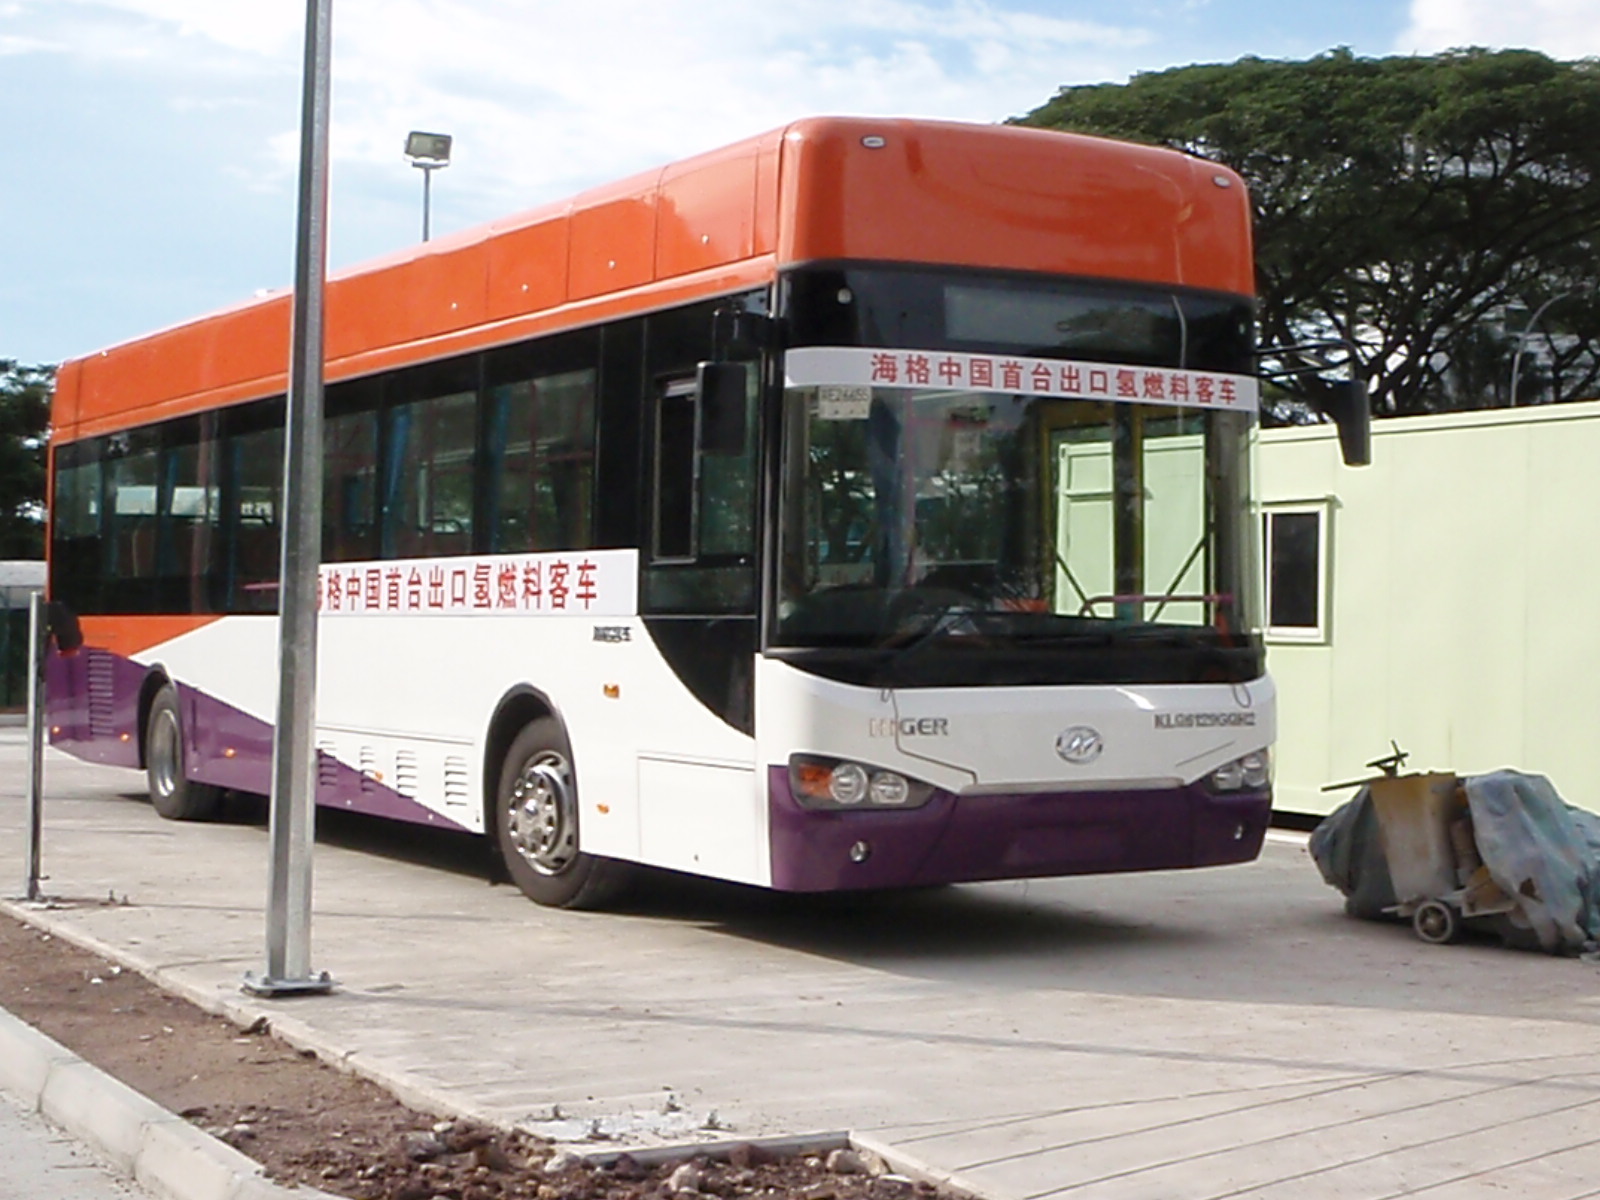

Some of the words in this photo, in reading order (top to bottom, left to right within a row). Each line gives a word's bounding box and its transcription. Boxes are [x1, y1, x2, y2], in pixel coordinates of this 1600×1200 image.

[871, 353, 1237, 405] 海格中国首台出口氢燃料客车
